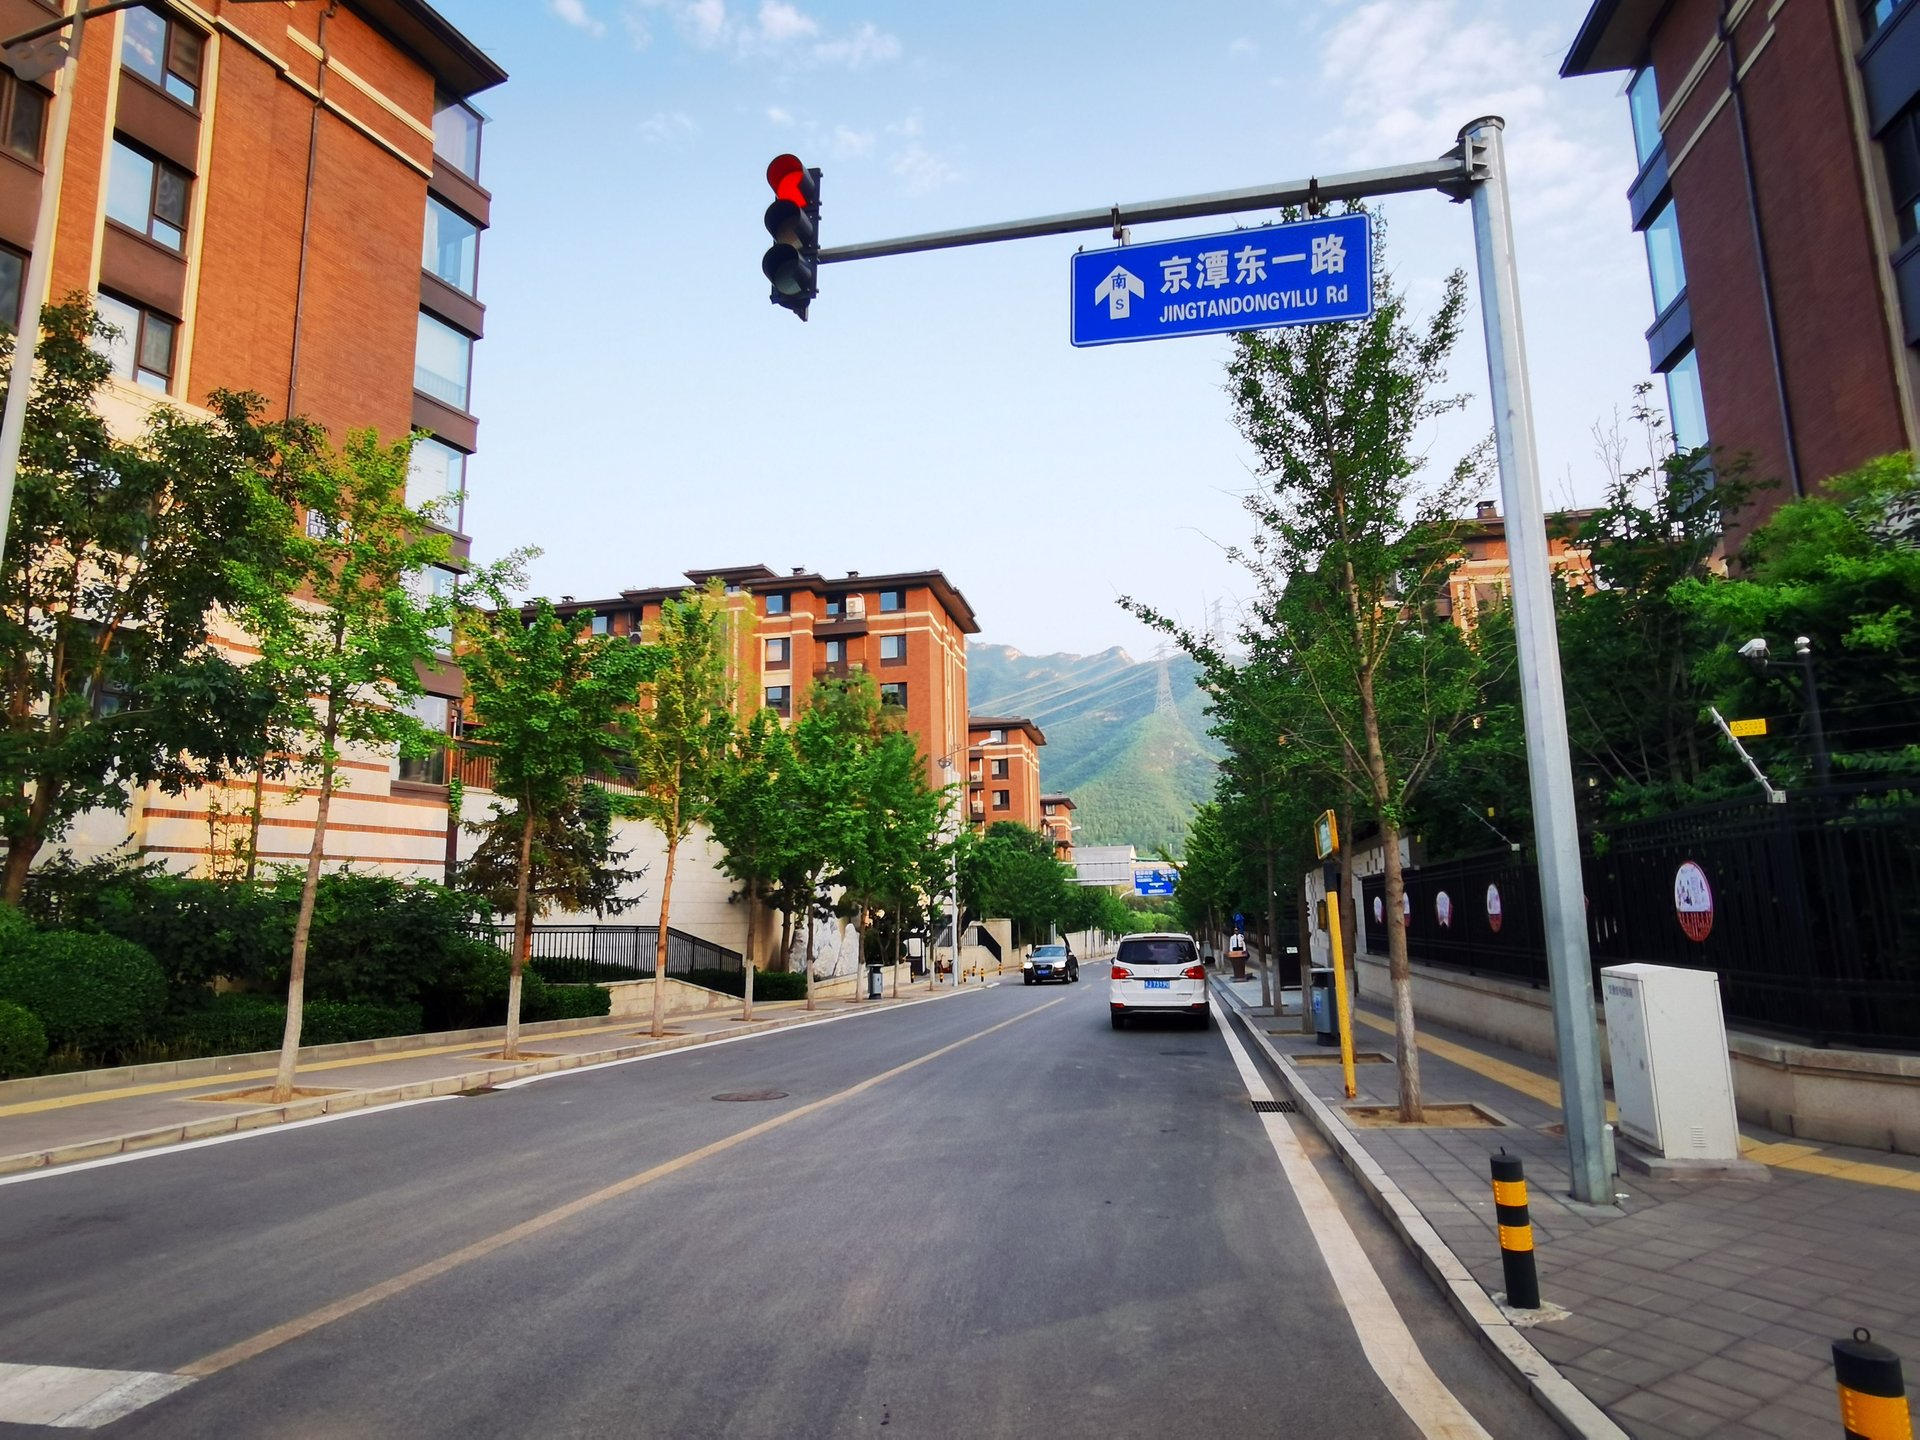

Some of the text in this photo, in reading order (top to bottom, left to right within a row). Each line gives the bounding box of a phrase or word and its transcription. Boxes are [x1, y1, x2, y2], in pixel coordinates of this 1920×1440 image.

[1160, 233, 1347, 294] 京潭东一路
[1111, 272, 1127, 290] 南
[1115, 298, 1124, 310] S
[1159, 284, 1348, 323] JINGTANDONGYILU Rd
